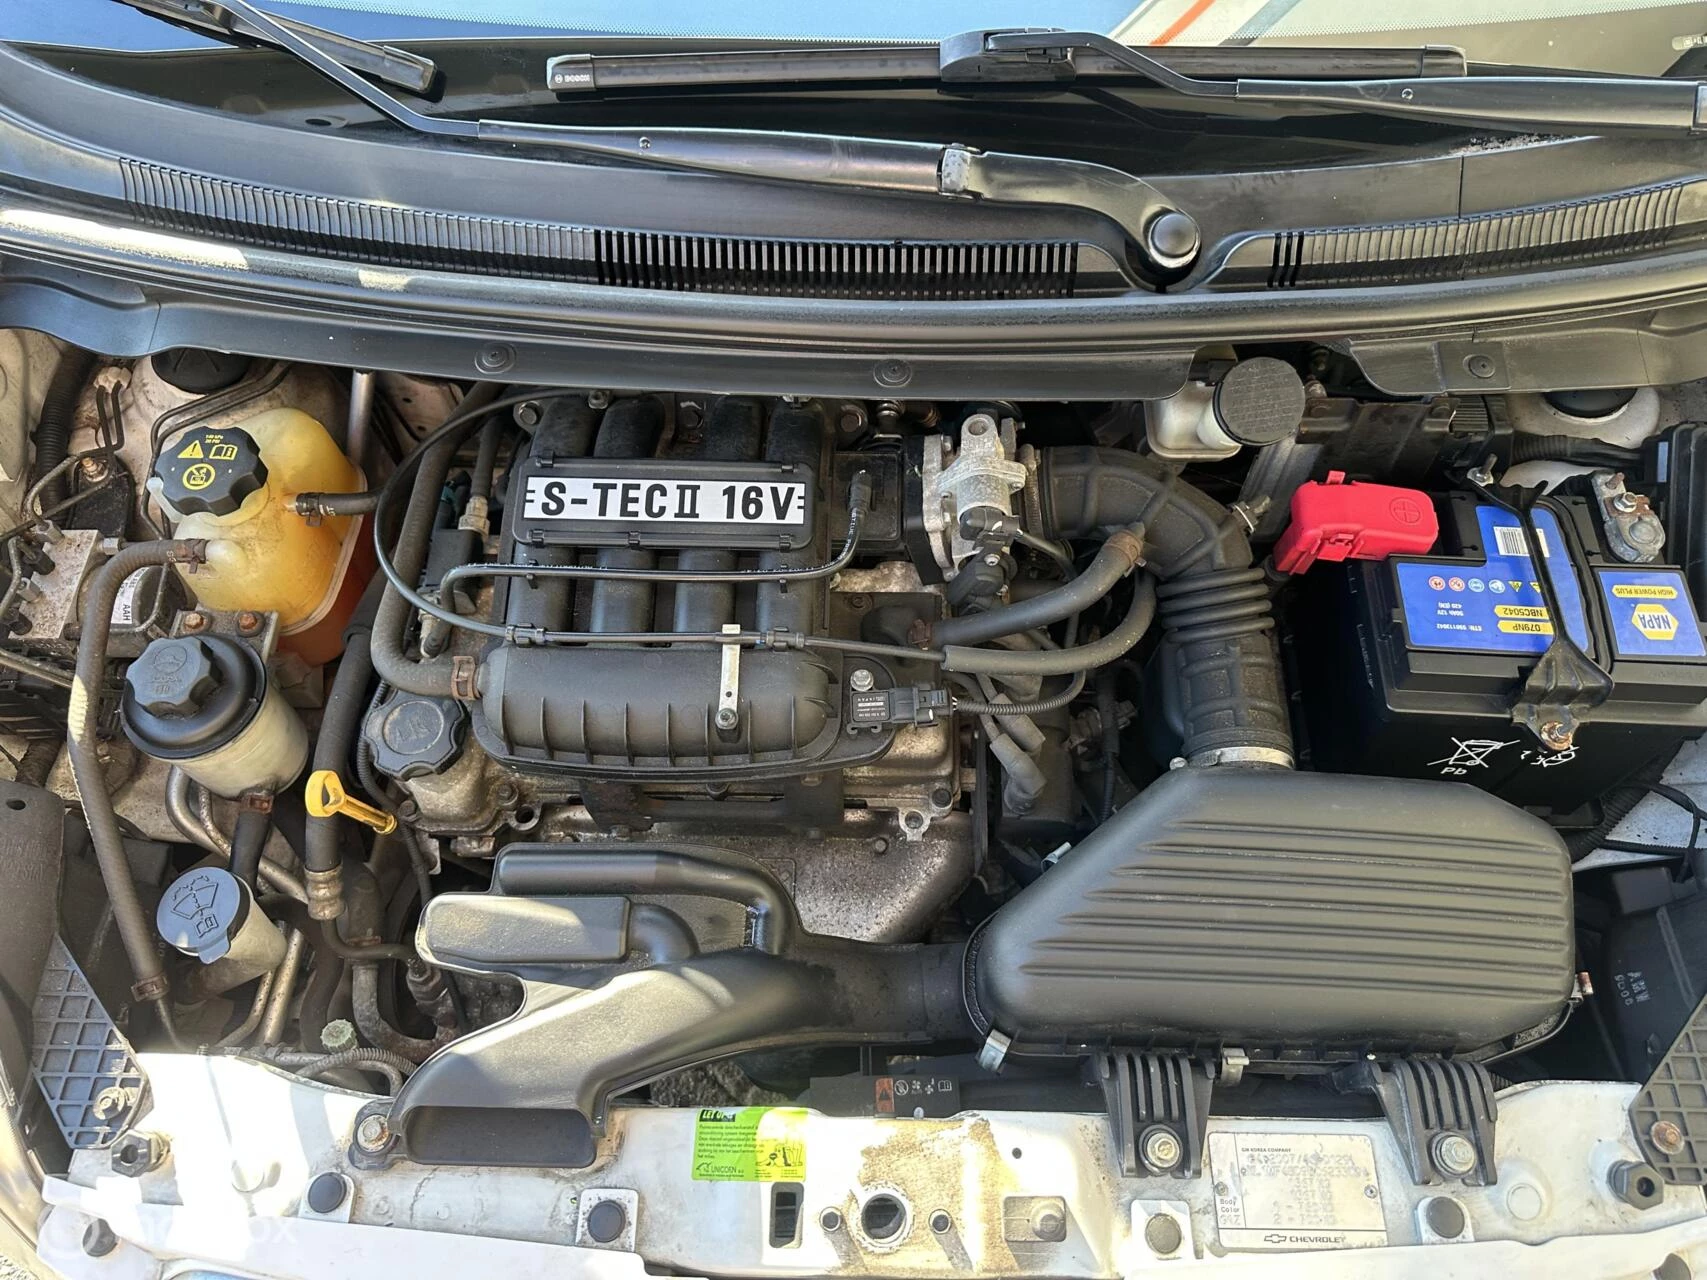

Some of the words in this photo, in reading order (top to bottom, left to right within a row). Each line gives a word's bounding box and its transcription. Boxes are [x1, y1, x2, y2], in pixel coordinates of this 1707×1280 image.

[721, 486, 796, 521] 16V
[122, 604, 131, 621] AAH
[1503, 608, 1542, 617] NBC5042
[1512, 623, 1541, 632] 079NP
[1638, 614, 1672, 630] NAPA
[1440, 766, 1468, 775] Pb
